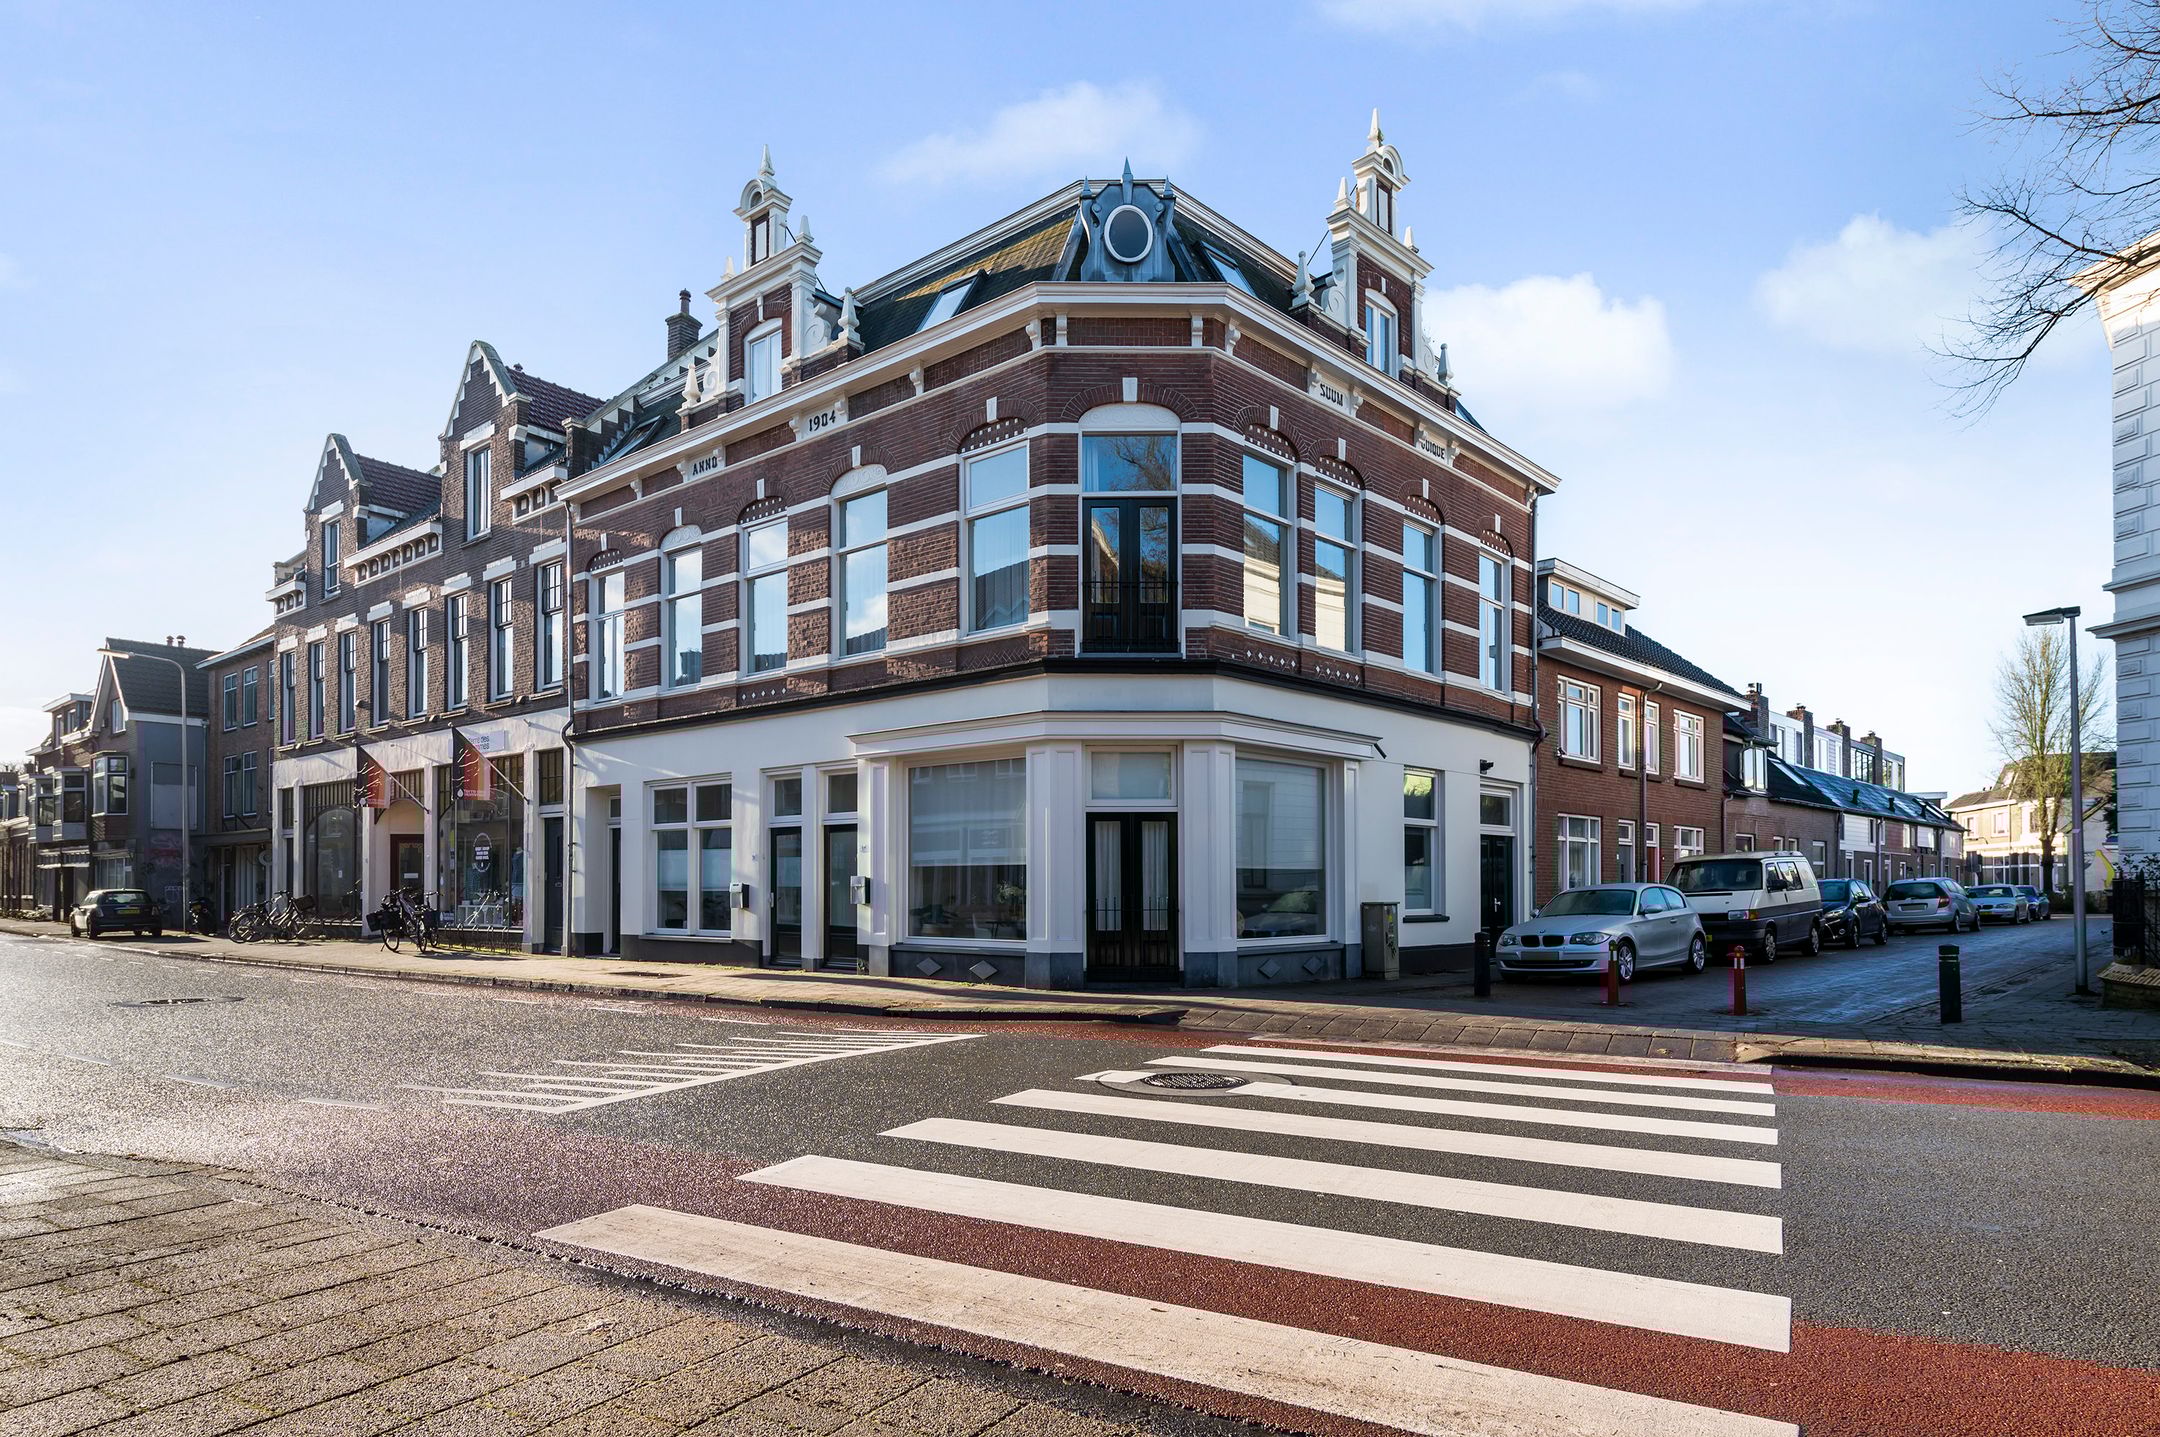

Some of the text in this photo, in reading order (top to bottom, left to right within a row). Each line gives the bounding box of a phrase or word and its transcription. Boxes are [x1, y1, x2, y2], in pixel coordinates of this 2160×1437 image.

[1320, 383, 1344, 407] SUUM
[692, 410, 836, 476] ANNO 1904
